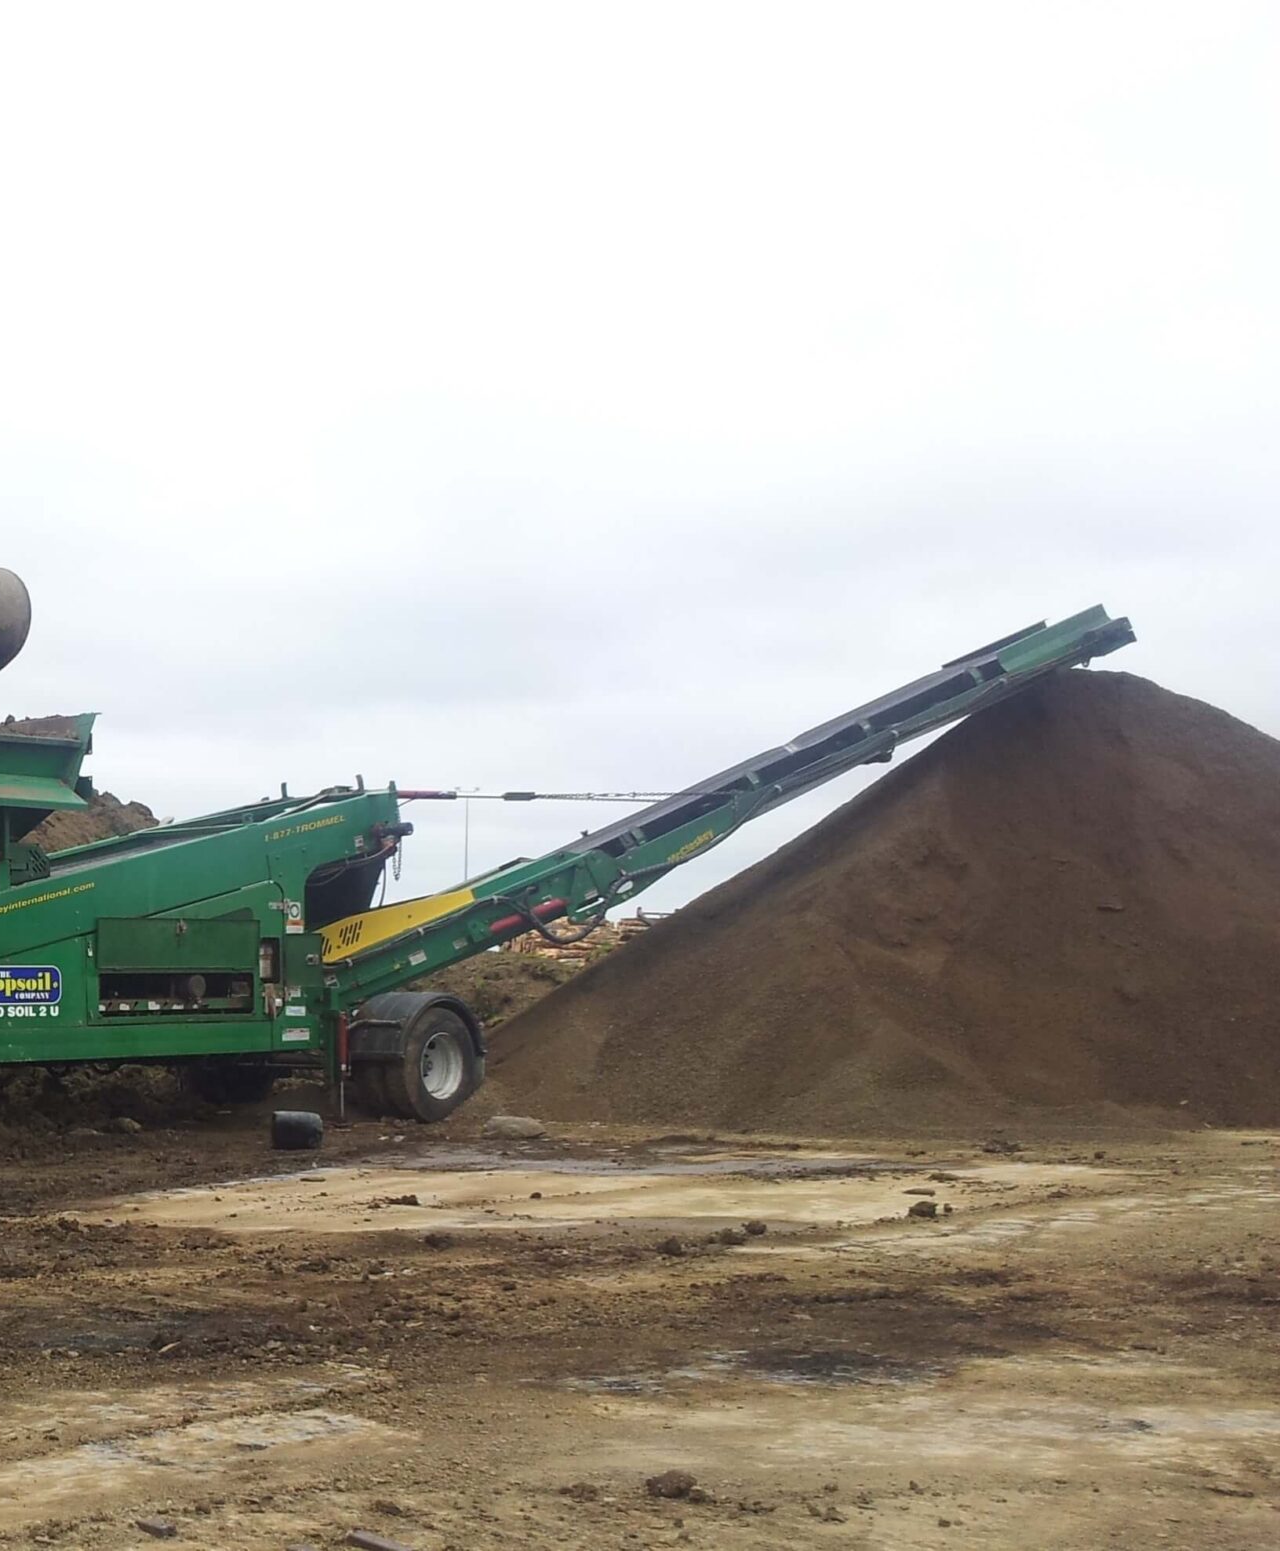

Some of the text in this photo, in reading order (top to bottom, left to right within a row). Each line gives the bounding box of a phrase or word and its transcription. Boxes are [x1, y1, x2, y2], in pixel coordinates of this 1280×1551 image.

[264, 815, 346, 842] 1-877-TROMMEL
[15, 992, 49, 1000] COMPANY
[7, 1006, 37, 1017] SOIL
[39, 1006, 47, 1017] 2
[50, 1006, 60, 1017] U
